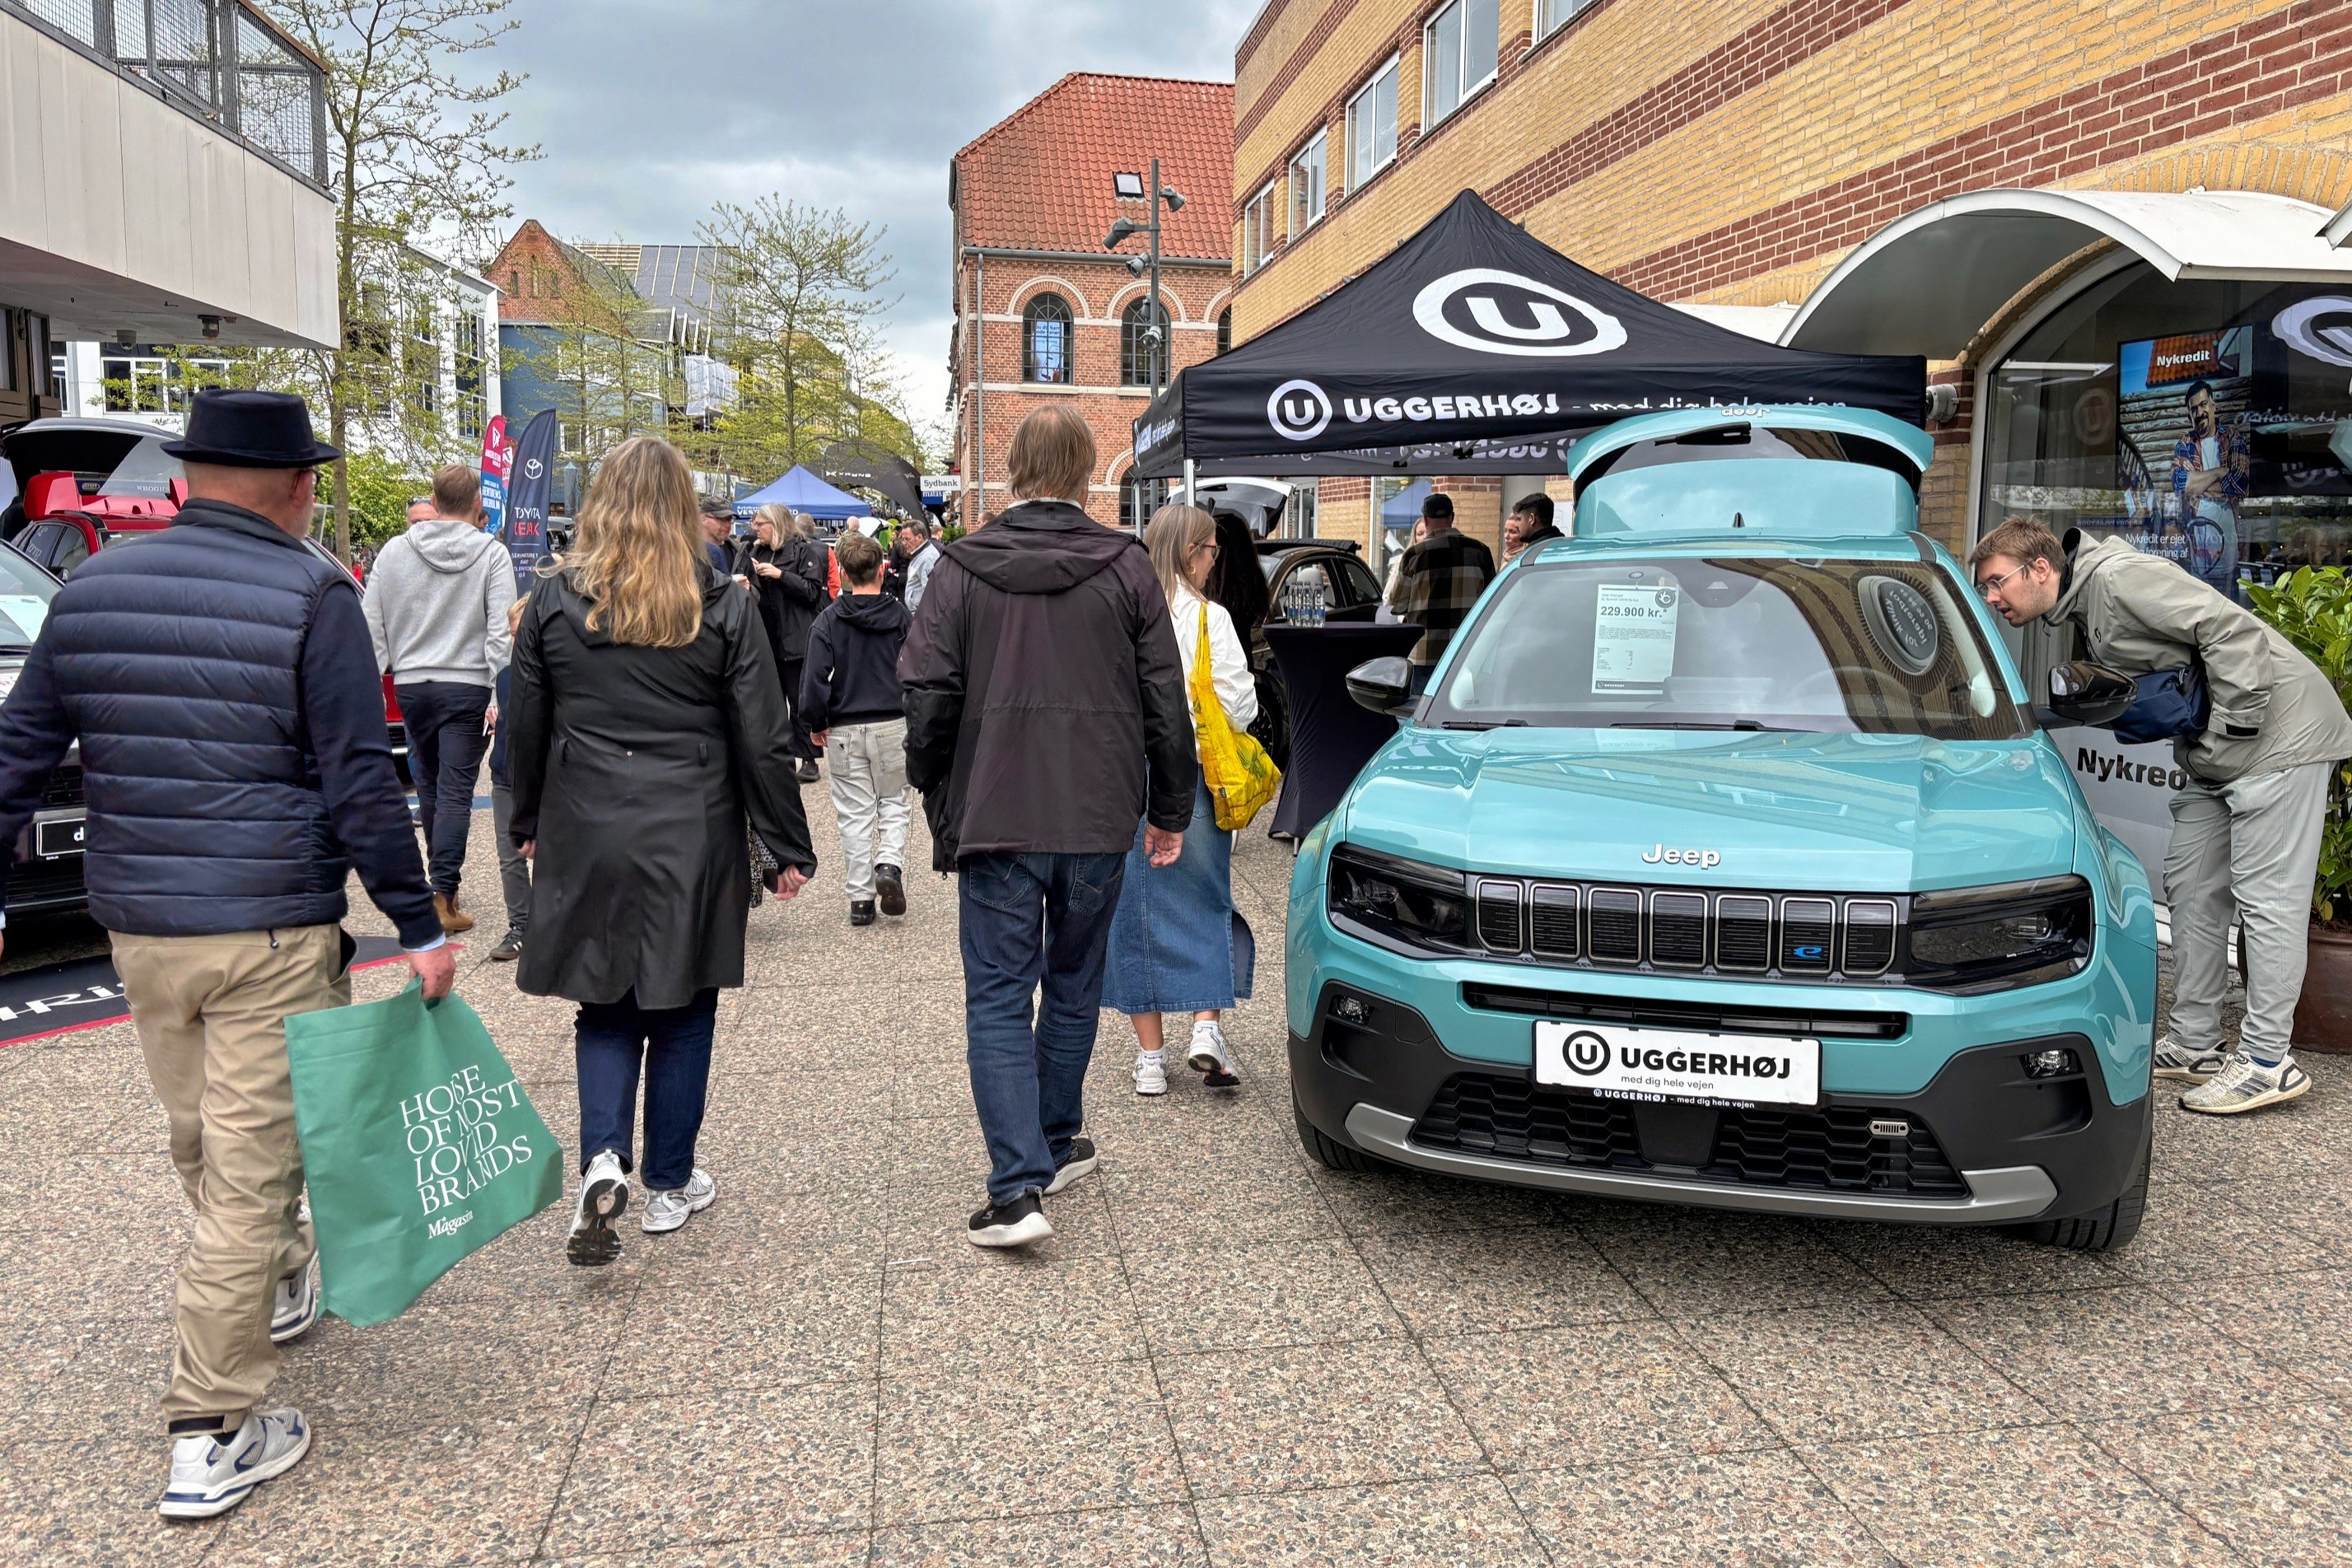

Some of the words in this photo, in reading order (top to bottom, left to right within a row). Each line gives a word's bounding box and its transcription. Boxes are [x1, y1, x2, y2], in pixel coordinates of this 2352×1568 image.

[2157, 350, 2210, 367] Nykredit
[1344, 394, 1560, 422] UGGERHØJ
[924, 479, 958, 488] Sydbank
[2126, 534, 2158, 545] Nykredit
[2170, 534, 2186, 546] ejet
[2180, 548, 2189, 558] af
[1601, 606, 1645, 617] 229.900
[1641, 843, 1721, 870] Jeep
[1621, 1047, 1790, 1080] UGGERHØJ
[1621, 1074, 1642, 1085] med
[1645, 1076, 1661, 1087] dig
[1664, 1078, 1685, 1088] hele
[1687, 1080, 1714, 1090] vejen
[1604, 1090, 1667, 1103] UGGERHØJ
[1677, 1096, 1695, 1104] med
[1696, 1097, 1710, 1107] dig
[1712, 1098, 1730, 1107] hele
[1732, 1100, 1755, 1109] vejen
[407, 1115, 451, 1155] OF
[418, 1136, 533, 1216] BRANDS
[428, 1210, 474, 1239] Magasin
